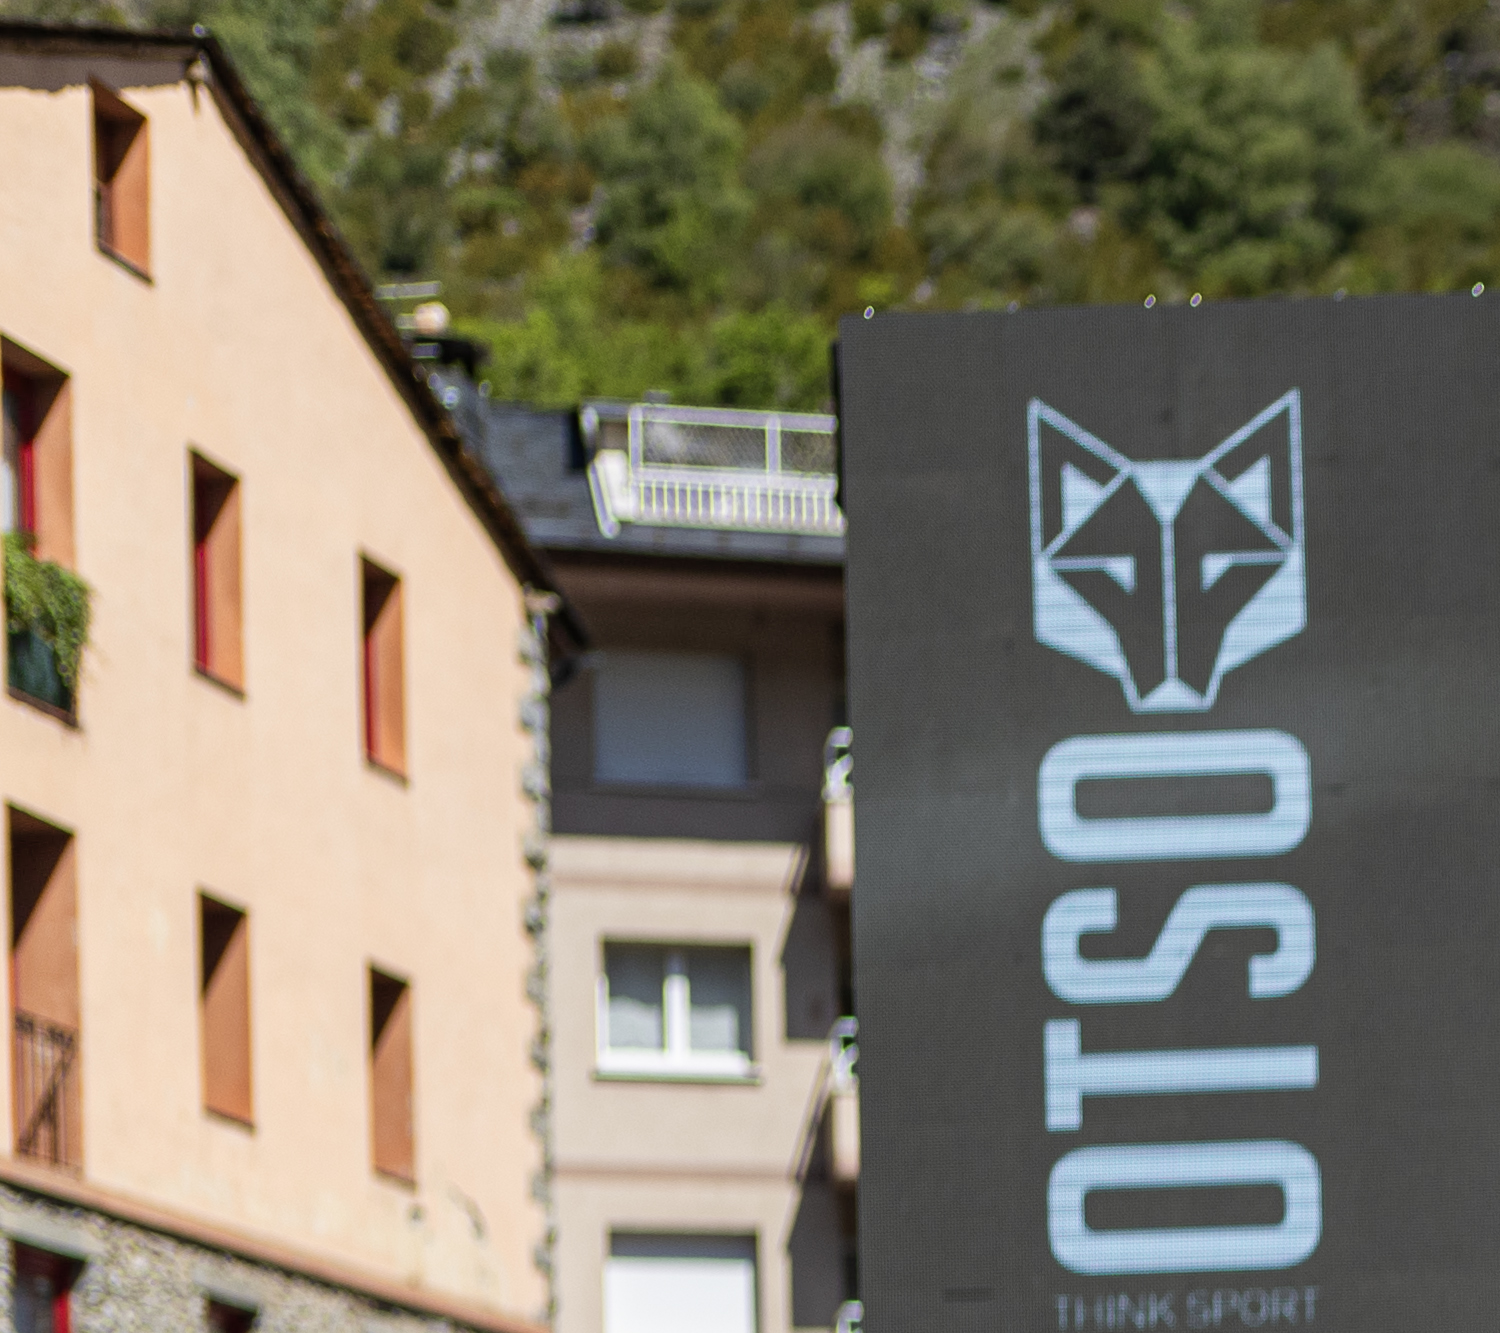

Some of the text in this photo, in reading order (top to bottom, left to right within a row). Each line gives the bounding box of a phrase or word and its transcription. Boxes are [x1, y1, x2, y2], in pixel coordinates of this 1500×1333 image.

[1037, 727, 1322, 1275] OTSO
[1054, 1285, 1322, 1331] THINK SPORT
